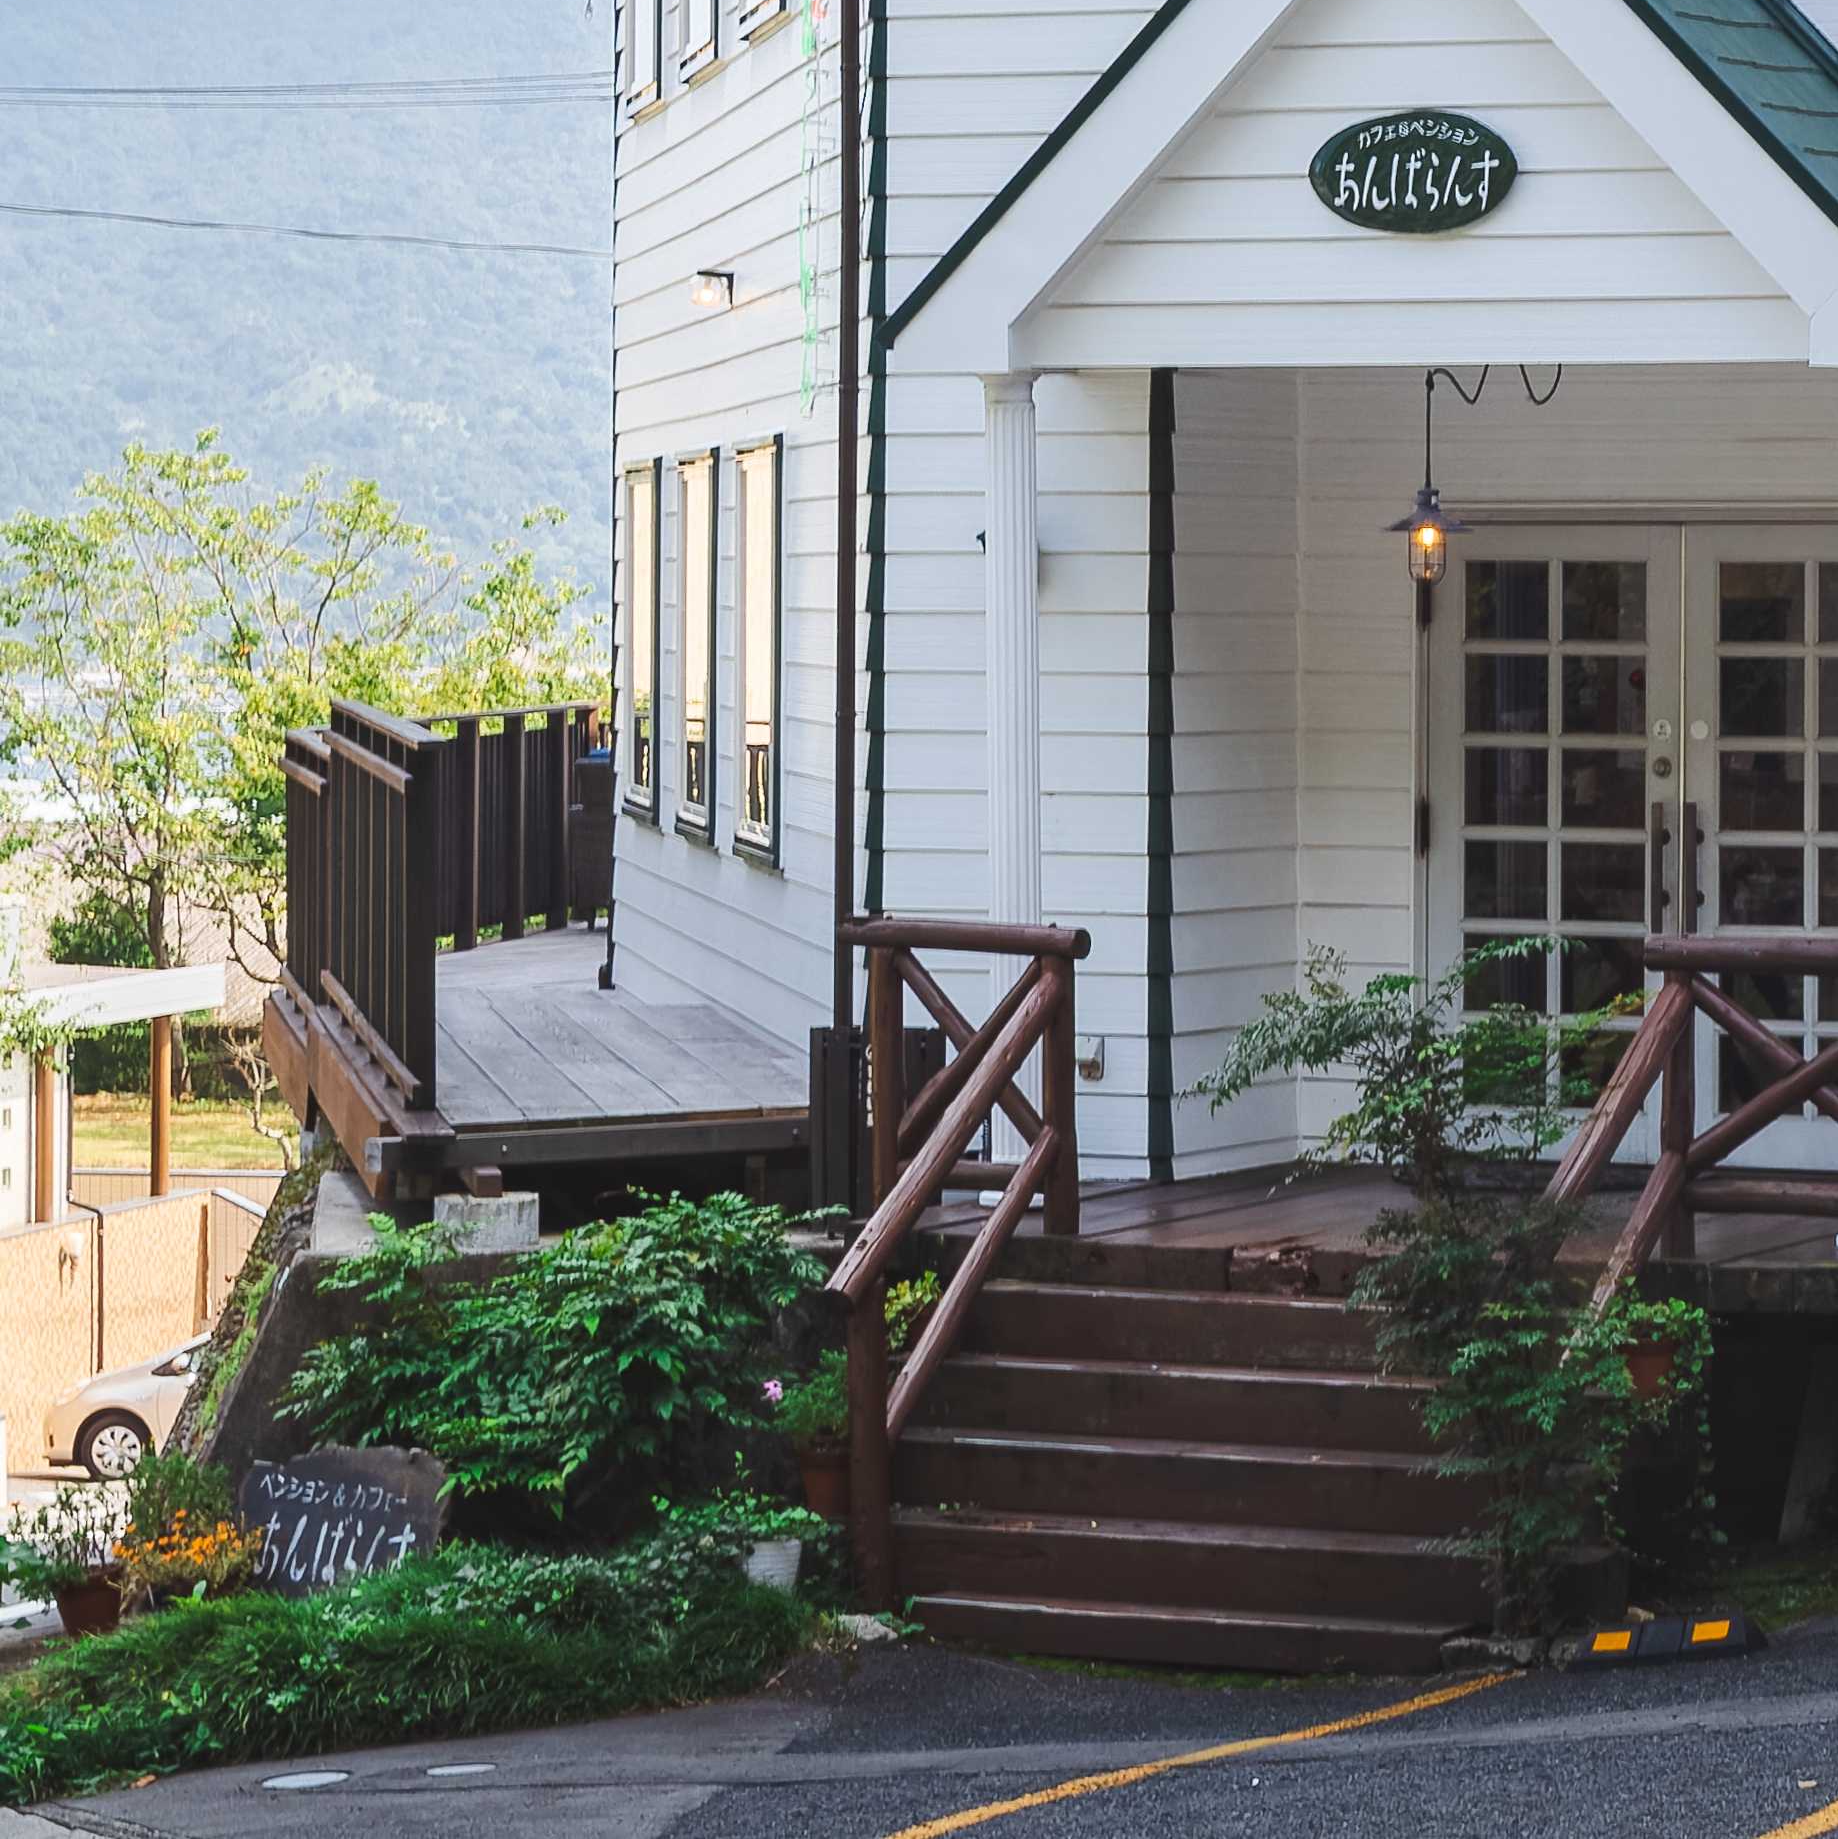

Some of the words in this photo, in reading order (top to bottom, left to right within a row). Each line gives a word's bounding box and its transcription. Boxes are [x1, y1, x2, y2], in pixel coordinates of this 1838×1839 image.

[1334, 147, 1500, 212] あんばらんす
